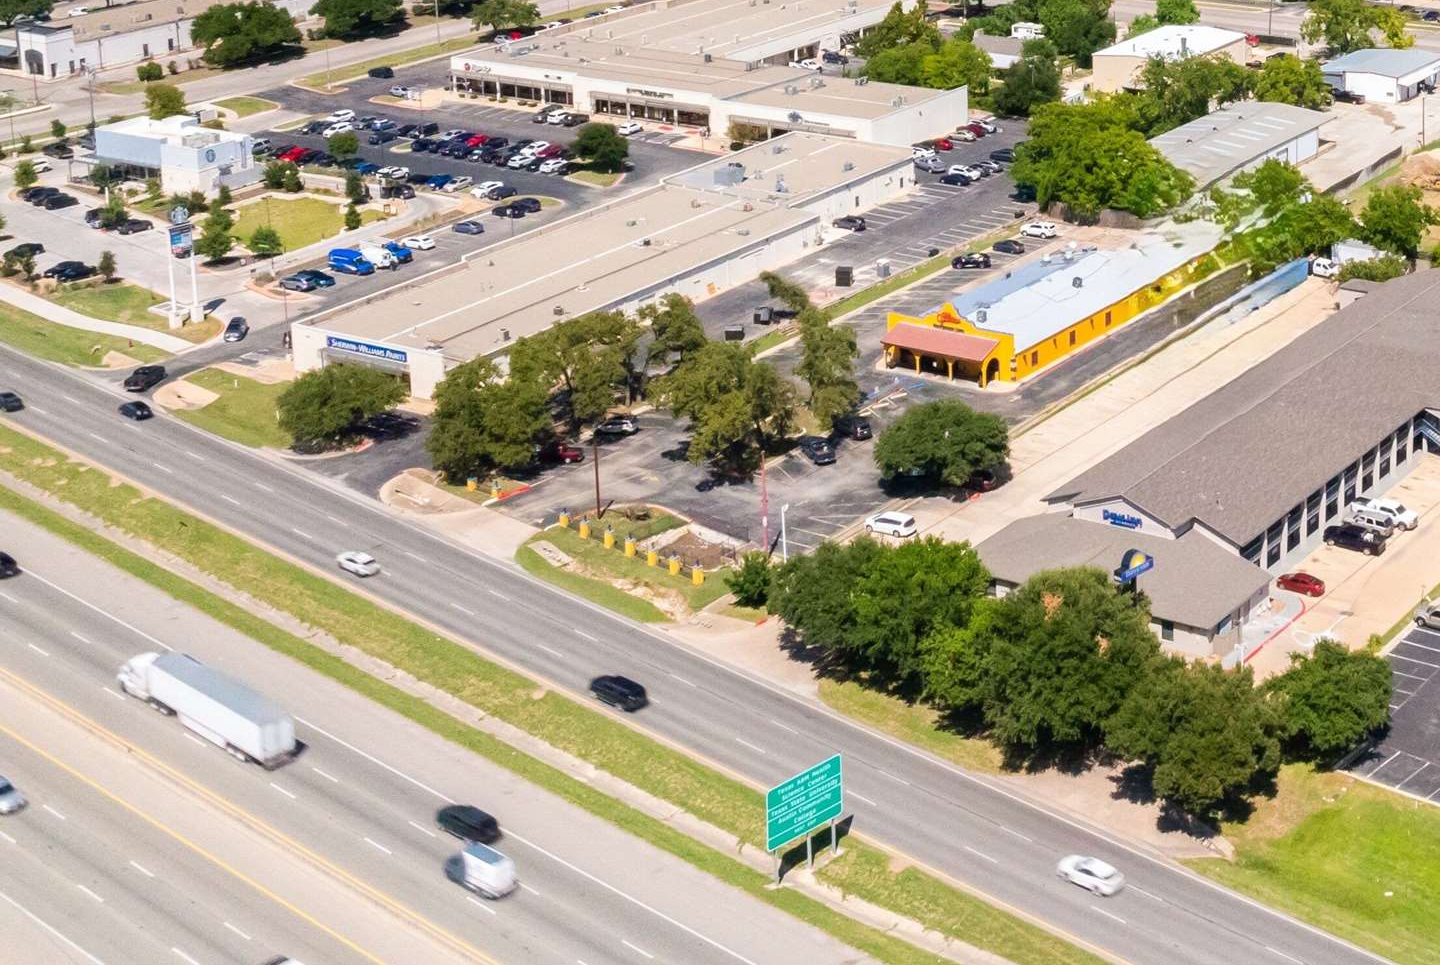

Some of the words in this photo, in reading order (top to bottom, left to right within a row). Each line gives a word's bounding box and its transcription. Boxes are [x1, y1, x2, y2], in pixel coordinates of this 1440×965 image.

[777, 783, 794, 795] Texas
[812, 763, 831, 777] Health
[782, 786, 805, 801] Science
[807, 773, 828, 787] Center
[771, 804, 788, 817] Texas
[790, 795, 806, 807] State
[809, 779, 838, 797] University
[778, 810, 797, 824] Austin
[798, 793, 832, 813] Community
[793, 808, 817, 824] College
